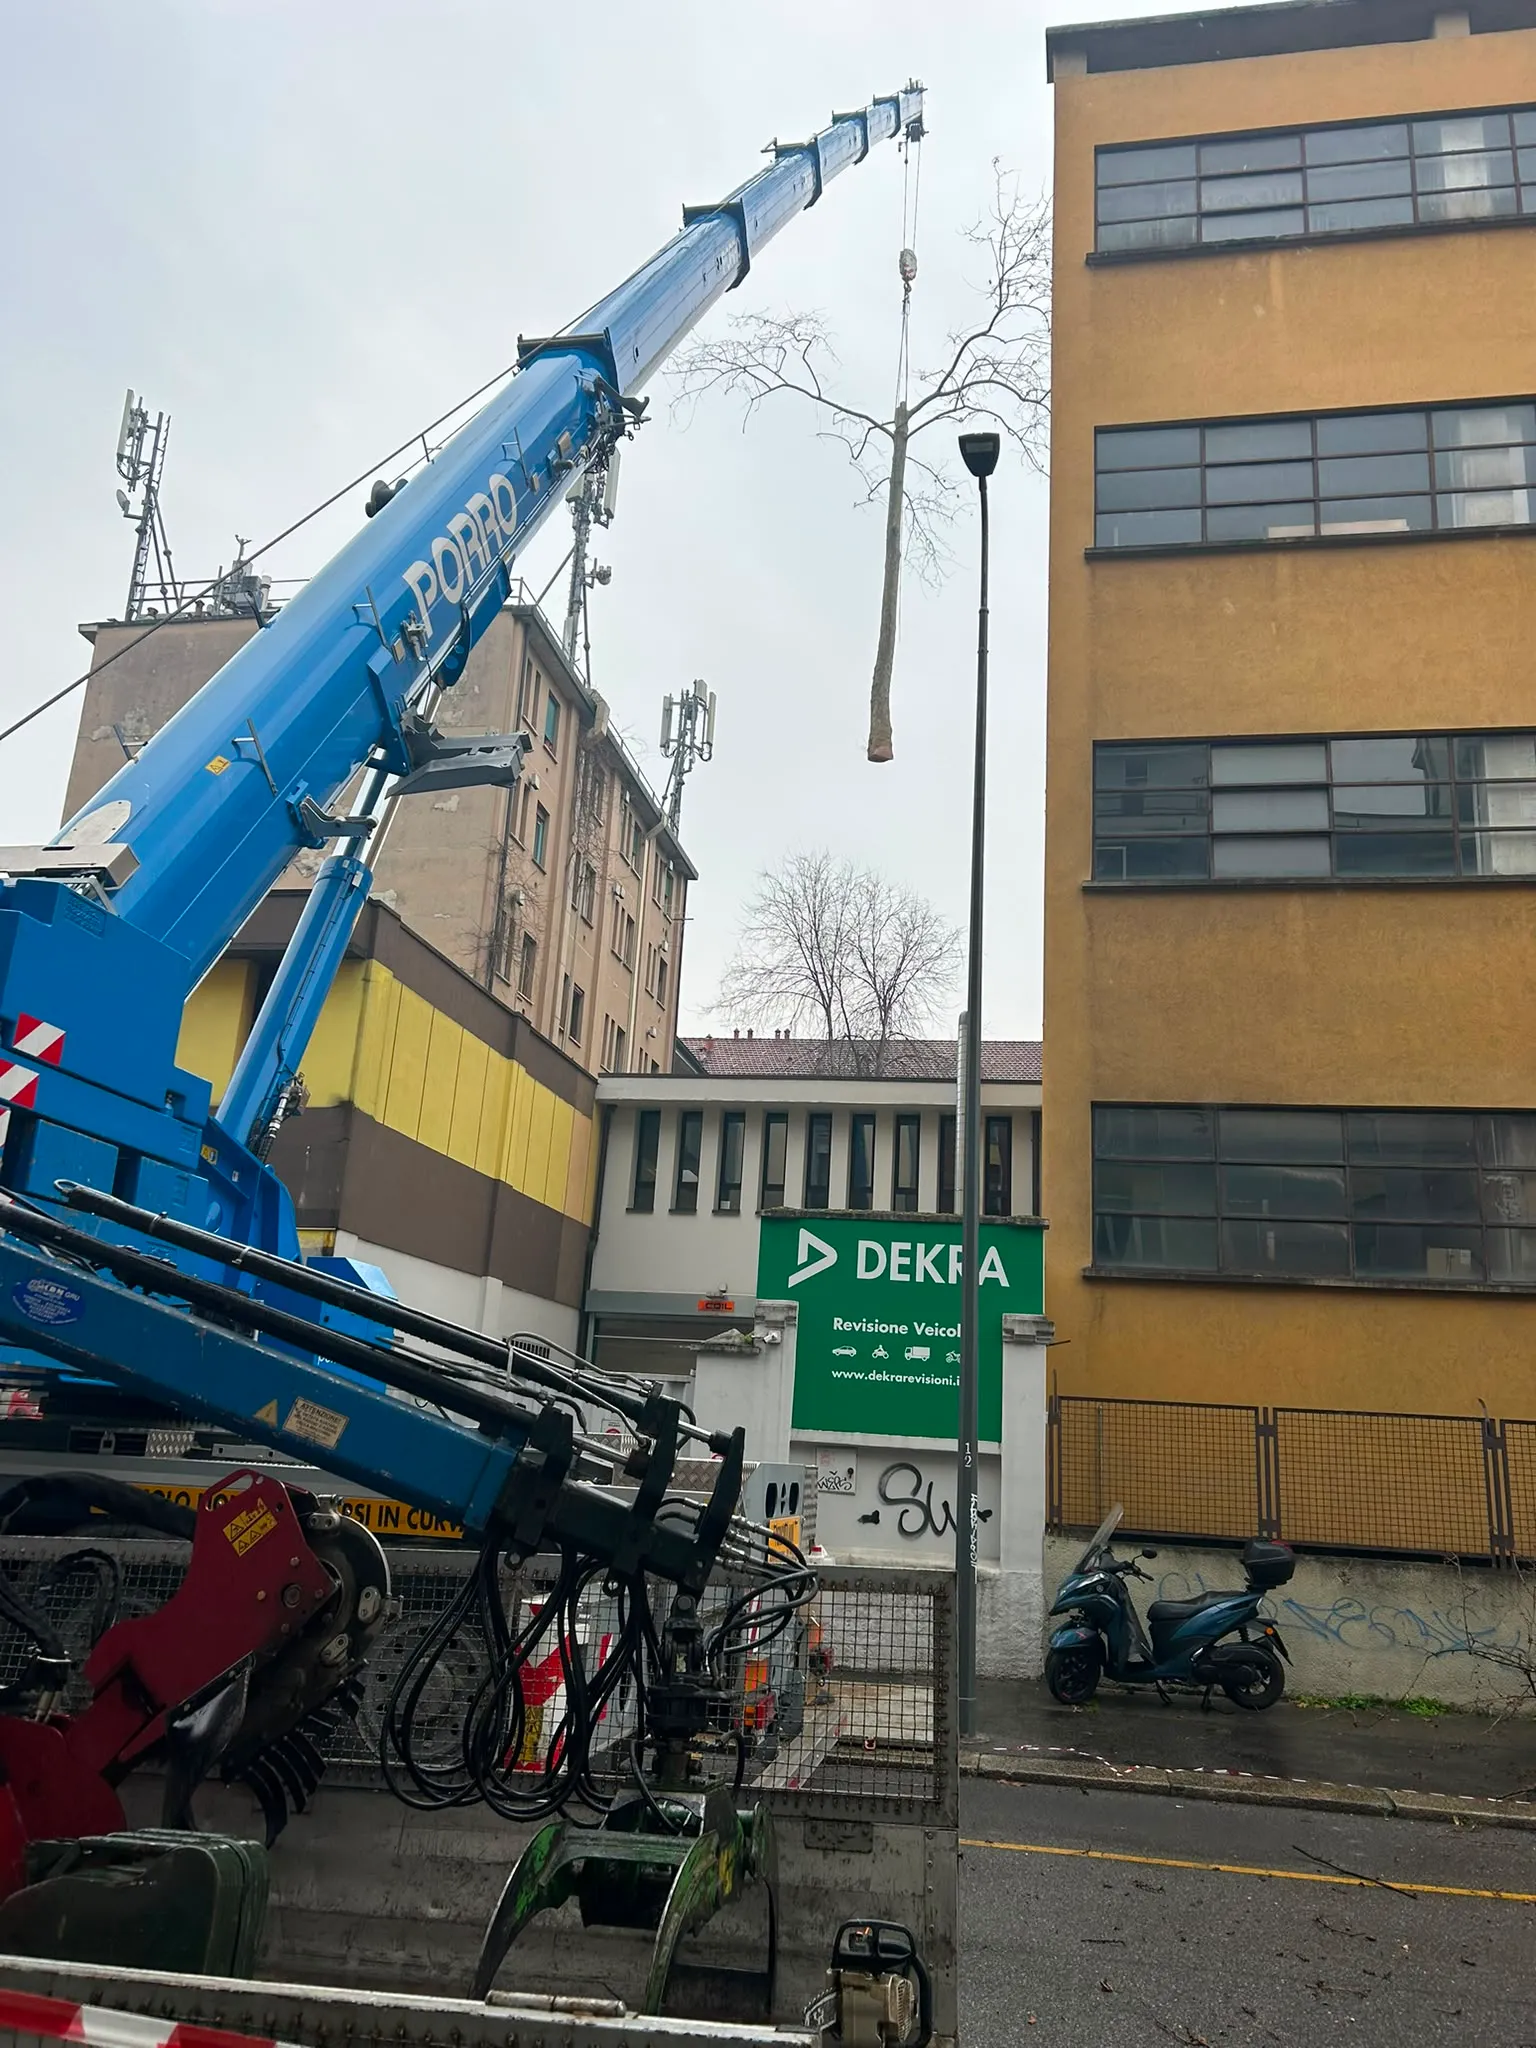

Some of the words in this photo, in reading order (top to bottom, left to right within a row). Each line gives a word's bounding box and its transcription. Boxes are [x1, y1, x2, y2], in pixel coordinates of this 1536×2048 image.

[402, 473, 518, 640] PORRO
[856, 1239, 1010, 1288] DEKRA
[833, 1317, 909, 1335] Revisione
[913, 1321, 962, 1338] Veicol
[831, 1369, 961, 1387] www.dekrarevisioni.i
[378, 1504, 400, 1529] IN
